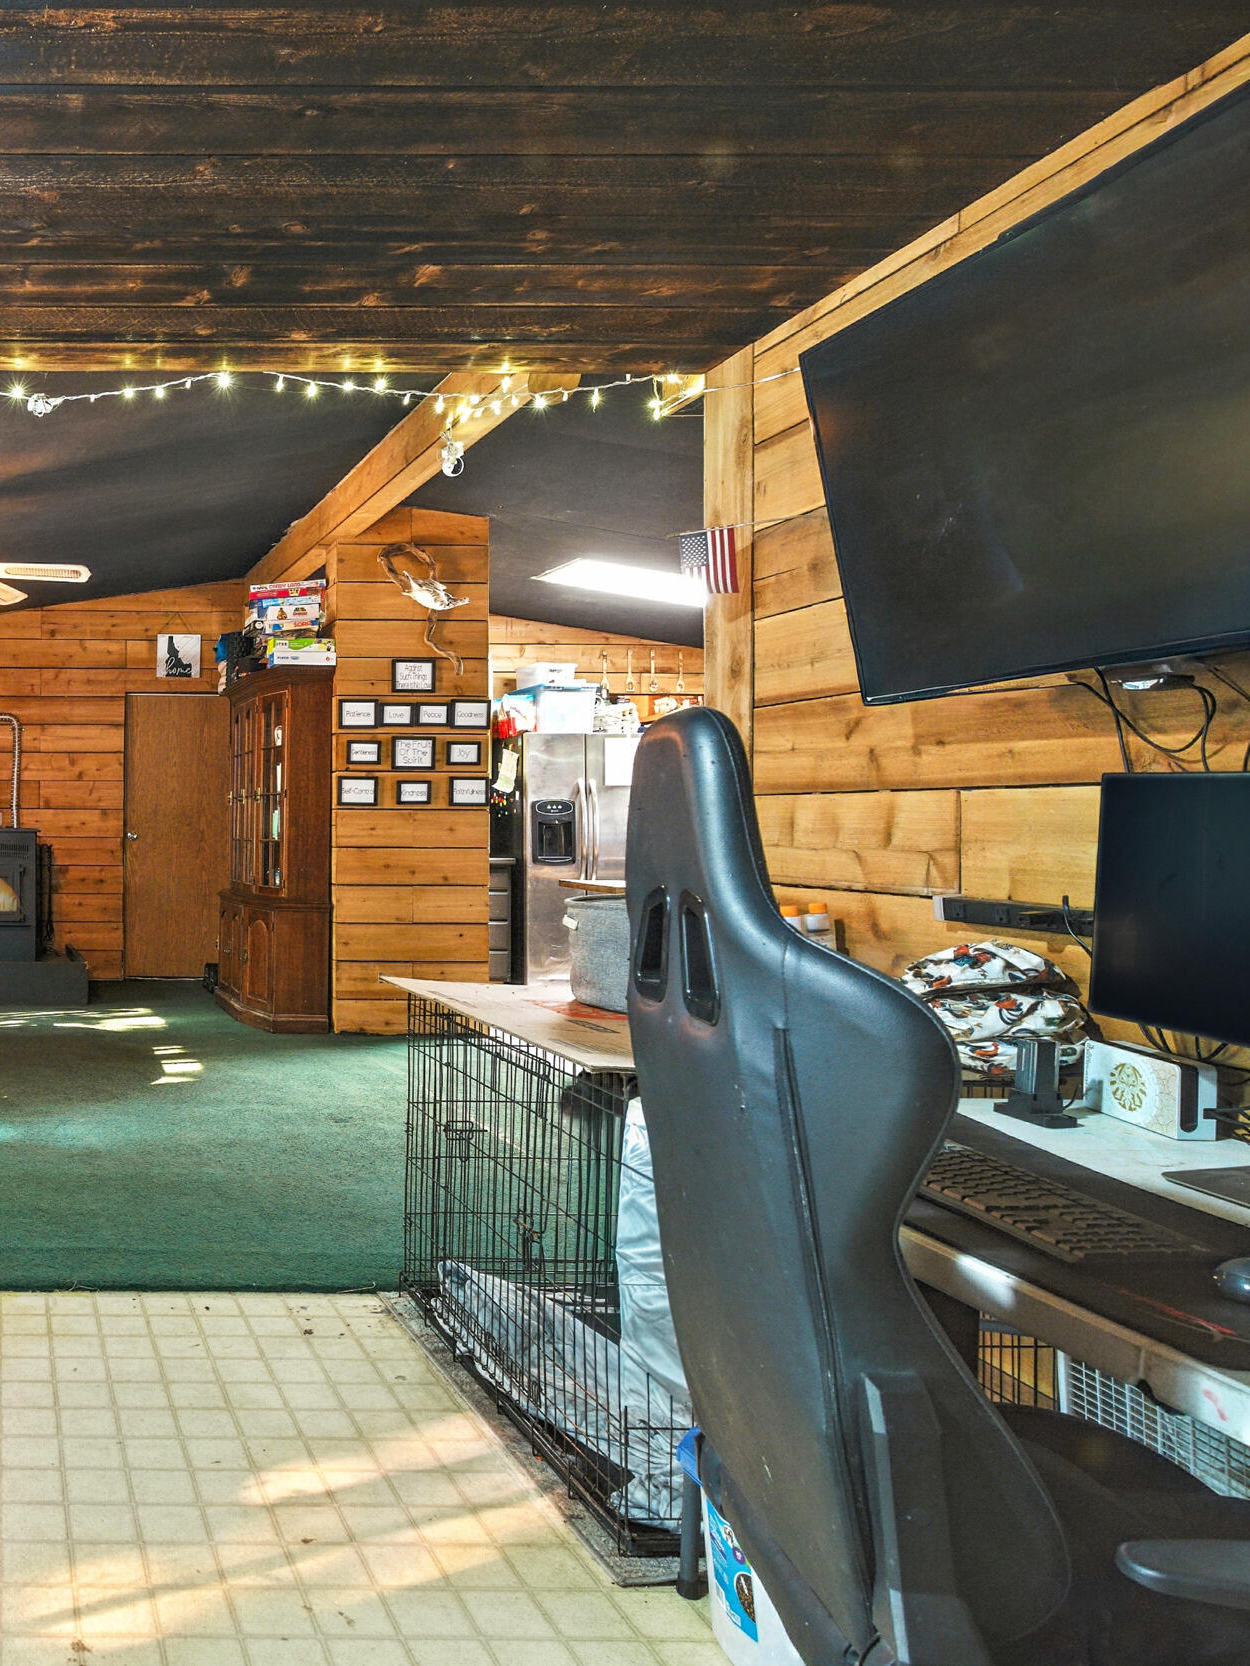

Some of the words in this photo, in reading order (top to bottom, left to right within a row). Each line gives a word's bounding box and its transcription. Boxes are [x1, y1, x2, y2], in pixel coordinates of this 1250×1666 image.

[166, 656, 192, 676] home
[345, 710, 371, 718] Patience
[388, 711, 405, 719] Love
[423, 710, 443, 718] Peace
[456, 710, 485, 718] Goodness
[456, 747, 471, 759] Joy
[341, 787, 375, 795] Self-Contro
